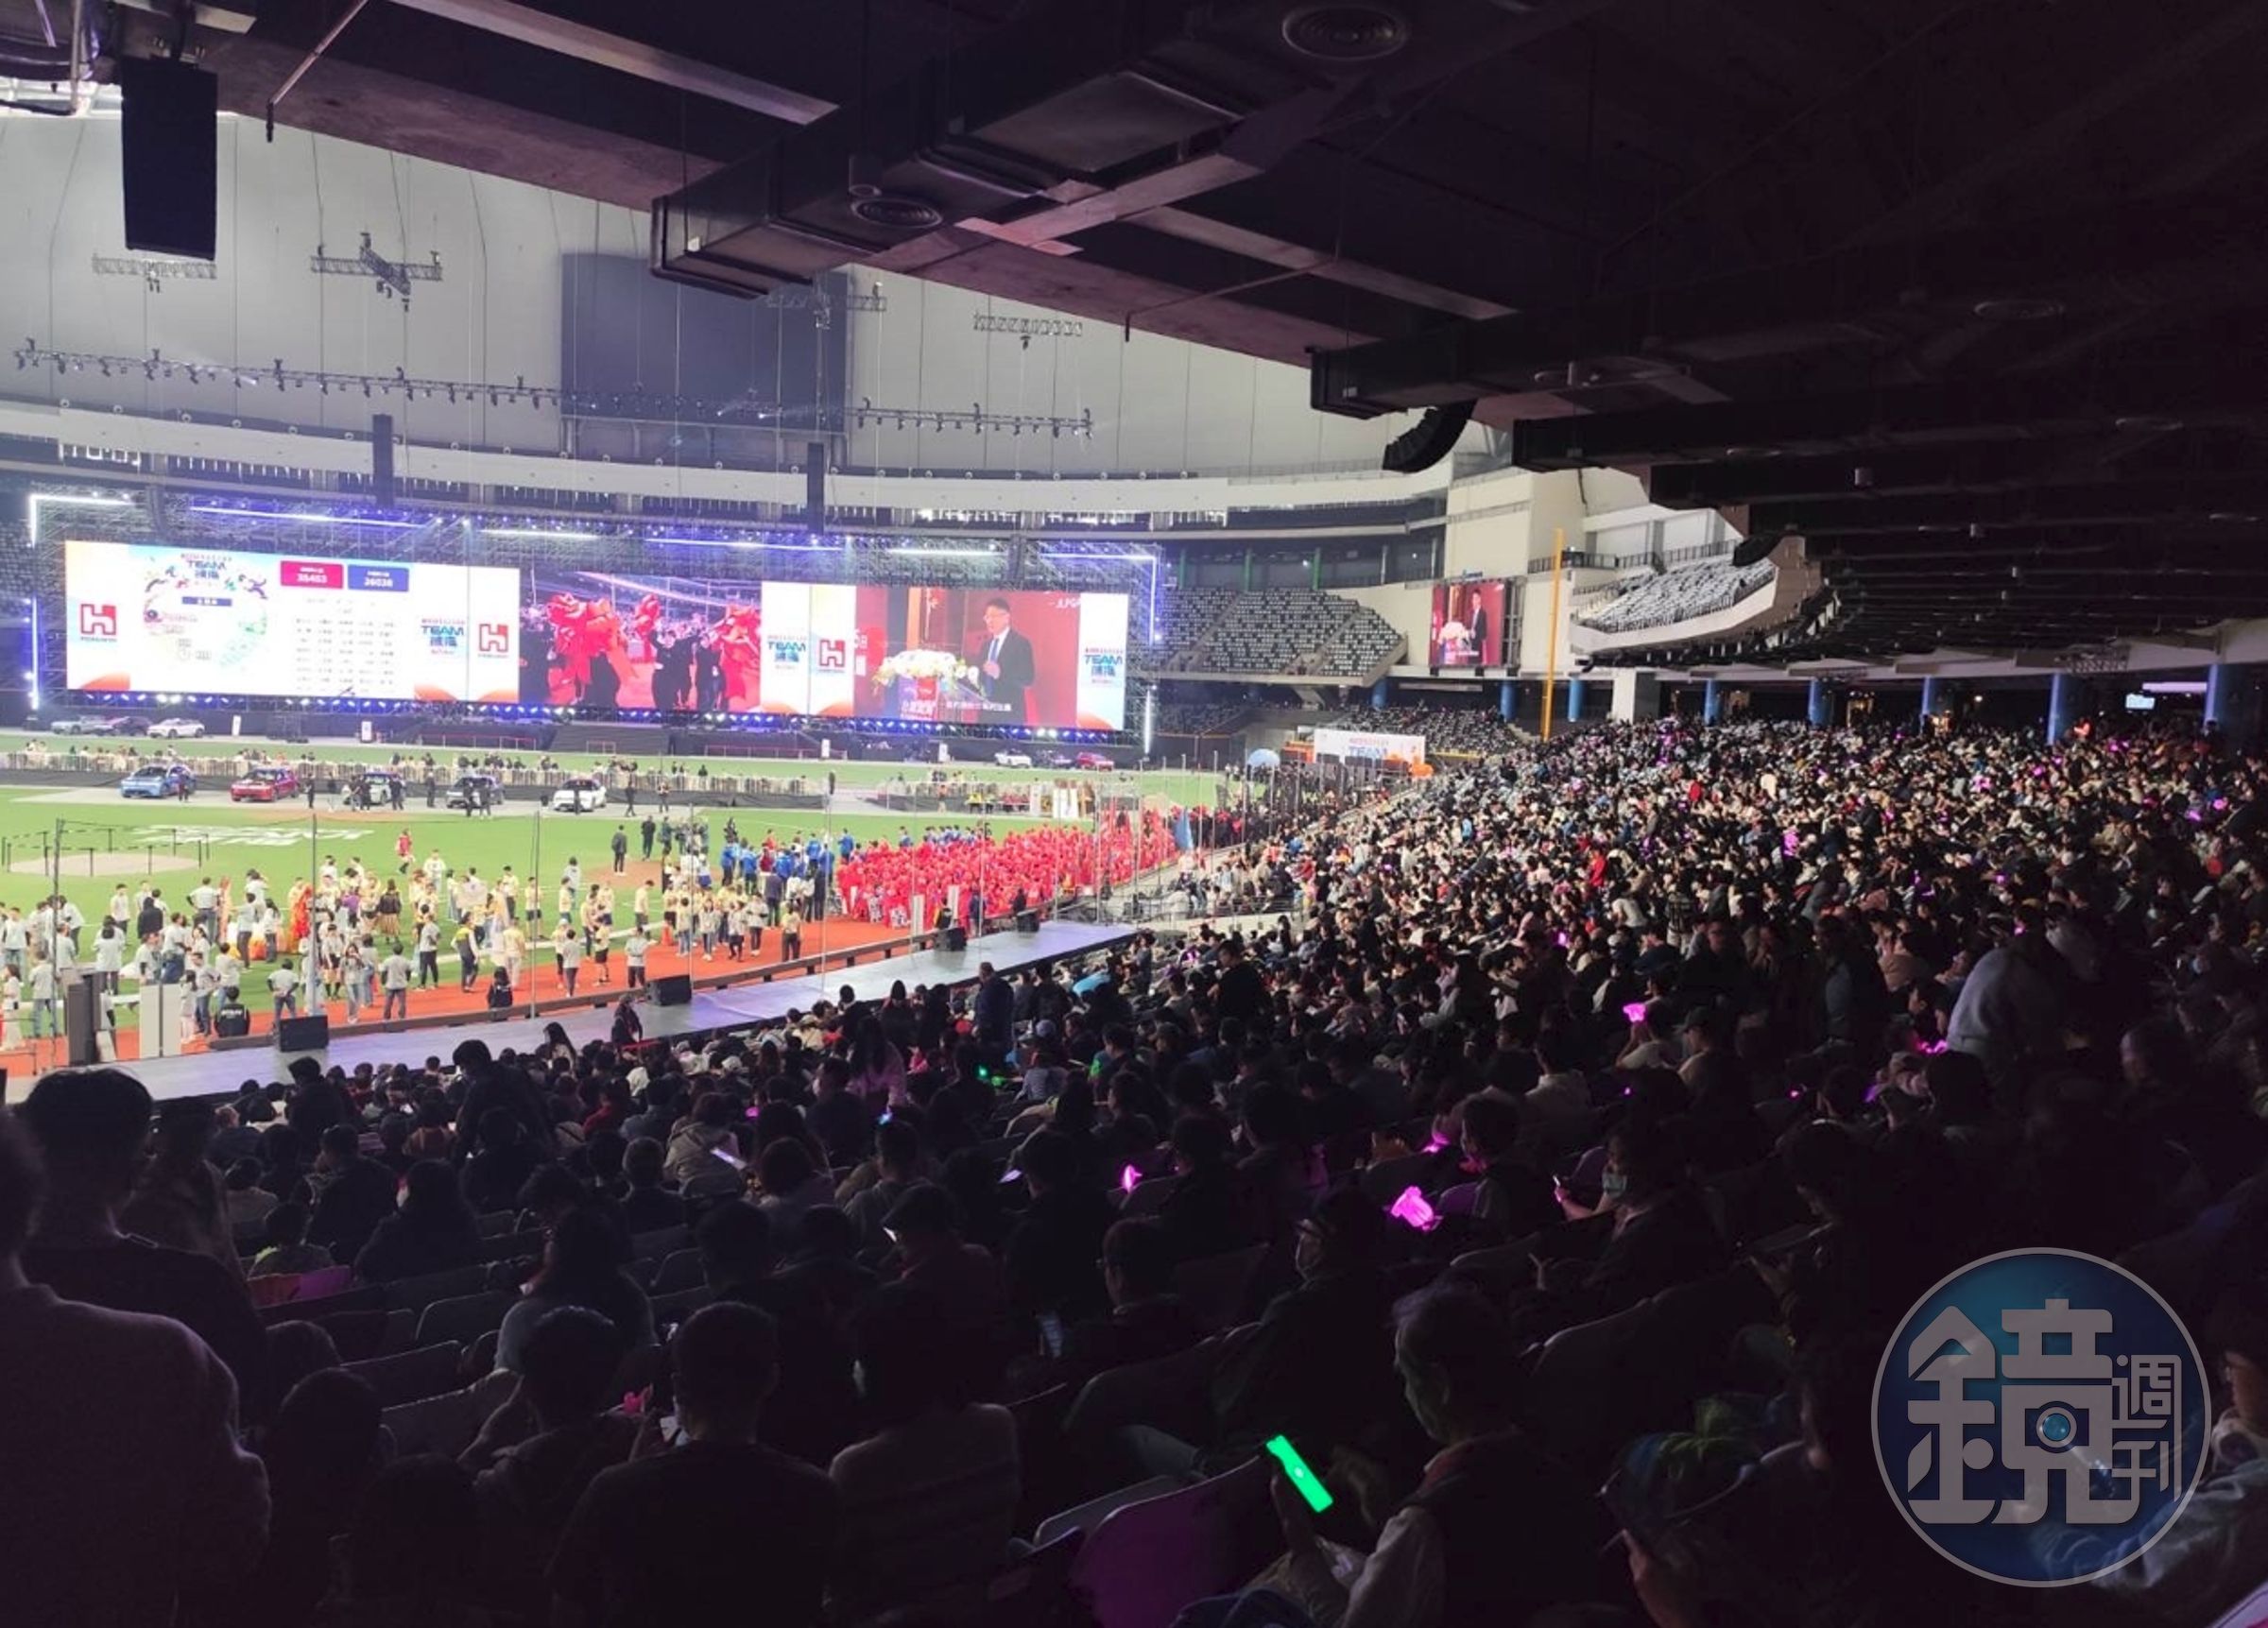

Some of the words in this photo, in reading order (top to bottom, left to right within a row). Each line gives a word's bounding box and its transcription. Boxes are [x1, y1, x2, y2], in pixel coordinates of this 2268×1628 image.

[421, 625, 465, 637] TEAM
[767, 641, 807, 652] TEAM
[1084, 654, 1124, 666] TEAM
